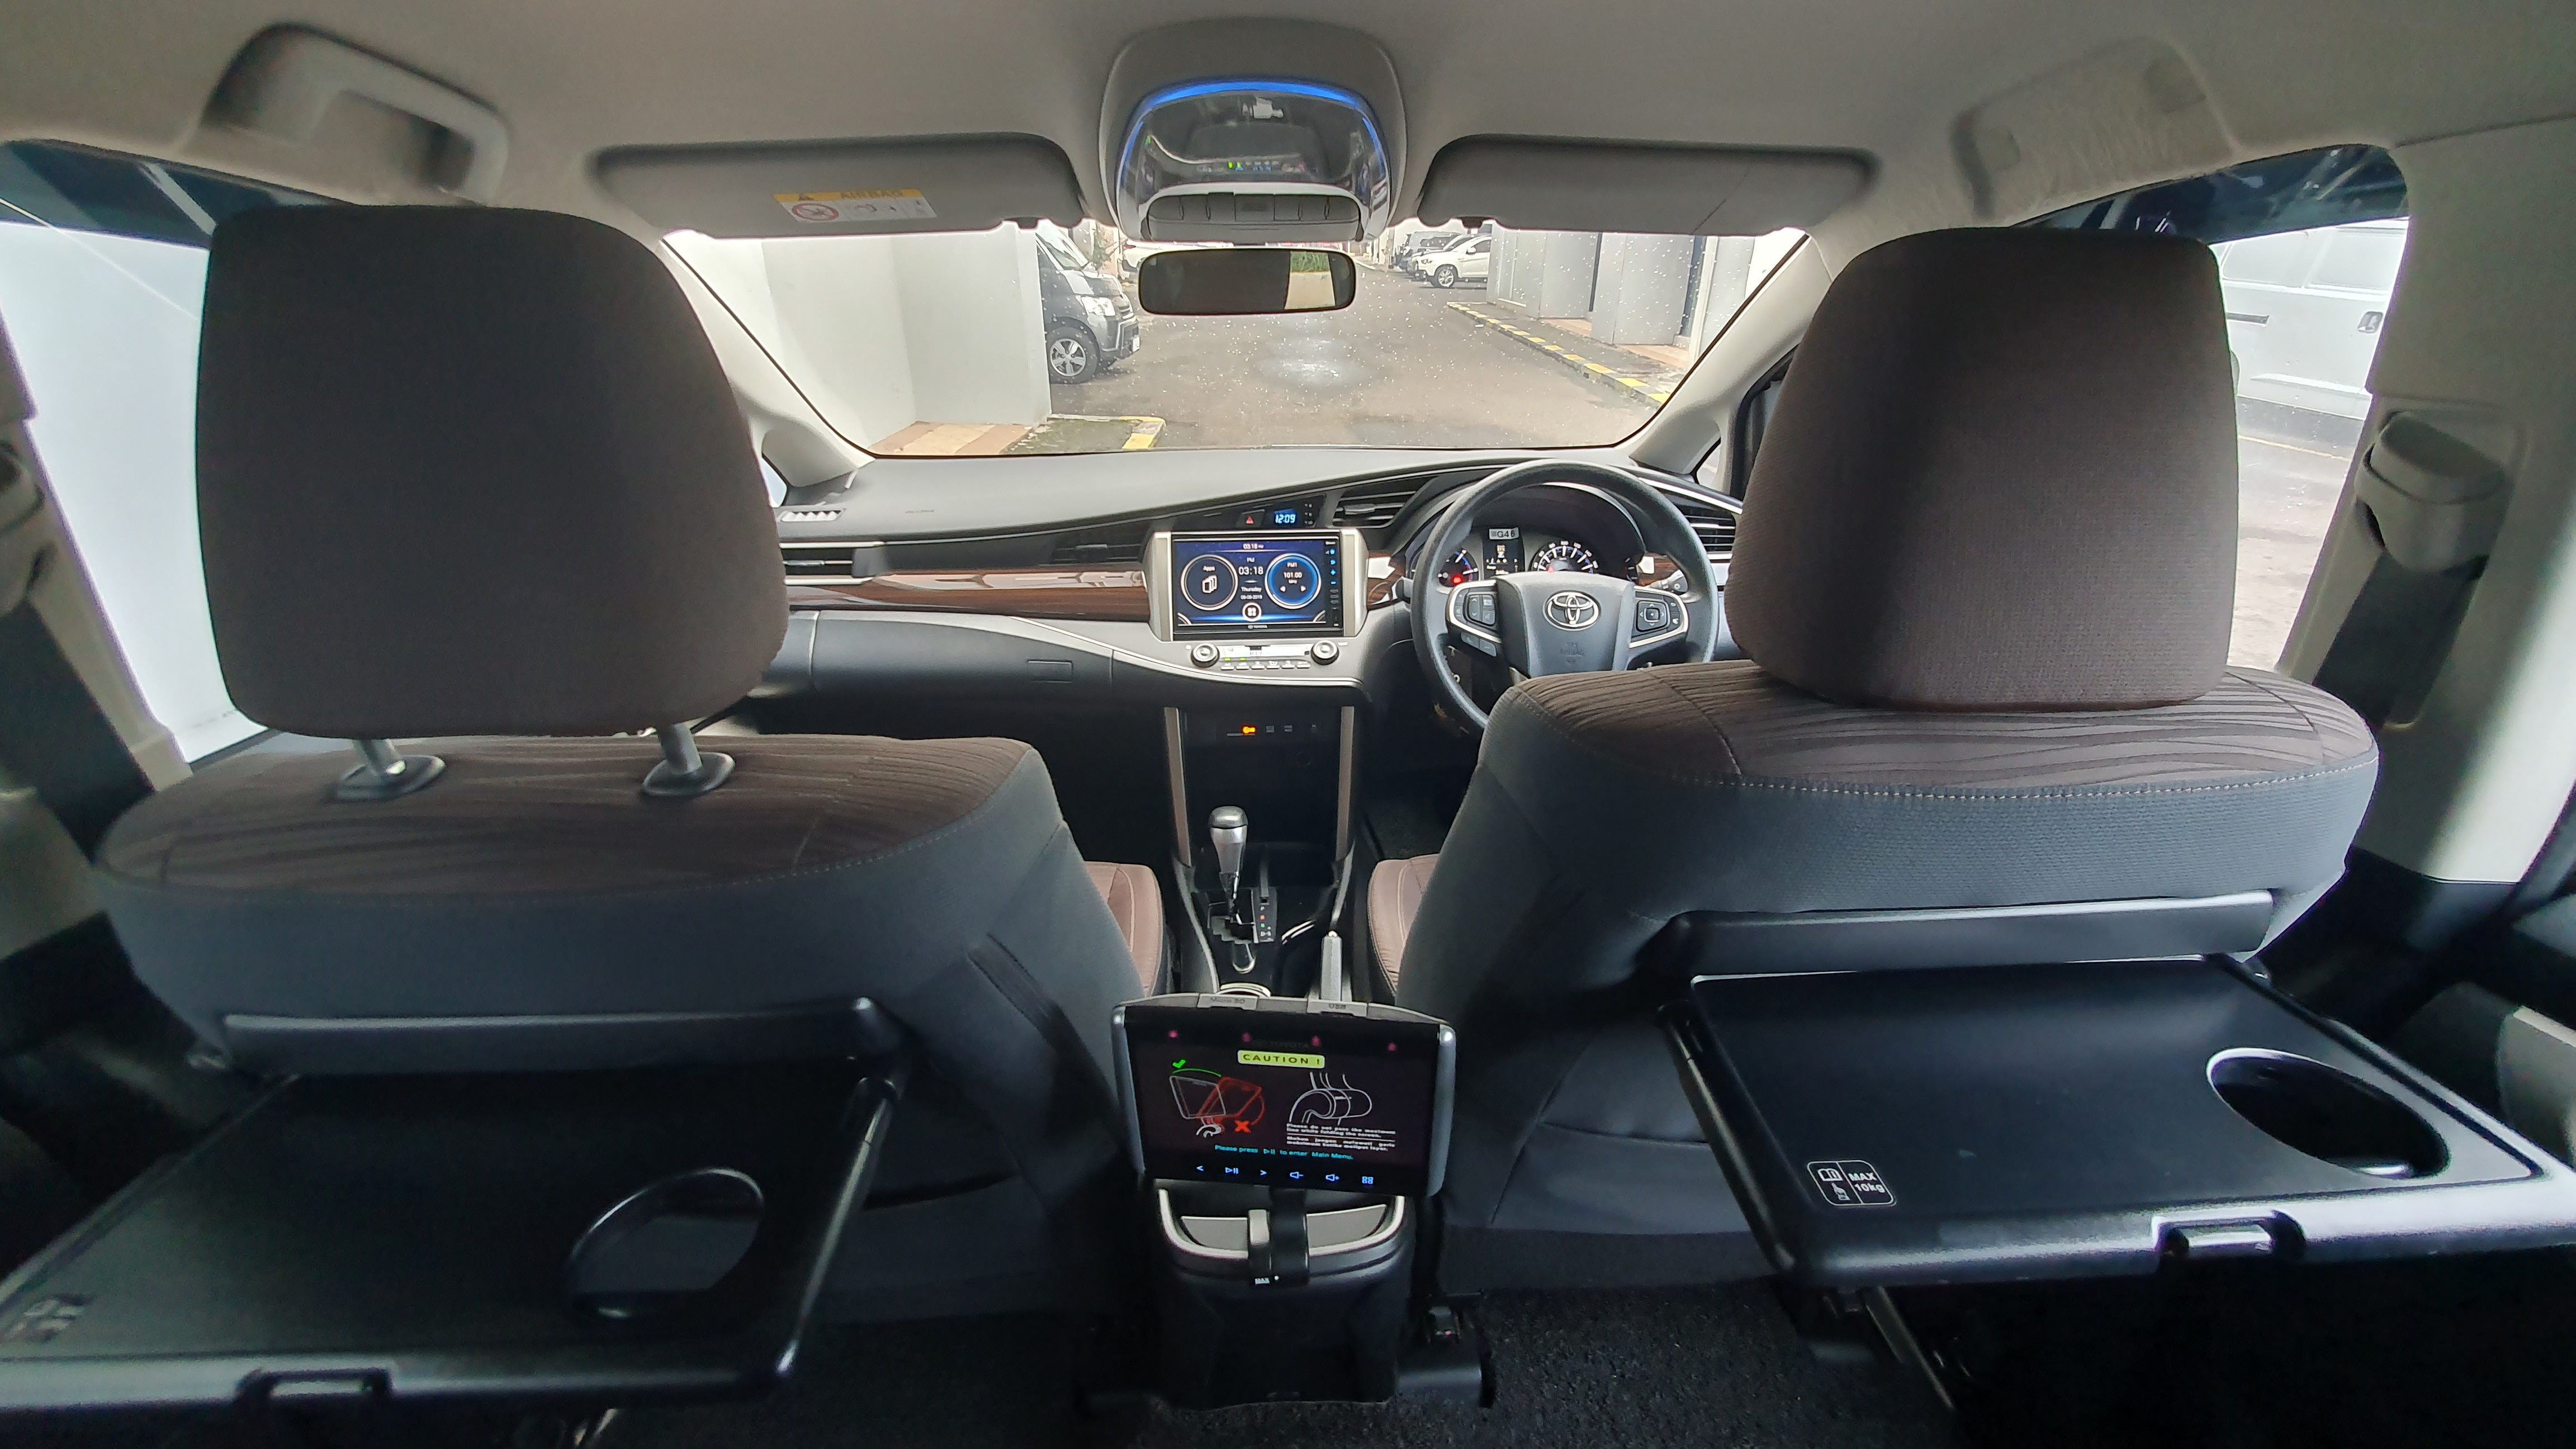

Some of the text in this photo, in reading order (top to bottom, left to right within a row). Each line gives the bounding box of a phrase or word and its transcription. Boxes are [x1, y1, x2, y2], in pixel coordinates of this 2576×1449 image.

[1275, 514, 1296, 524] 12:09
[1238, 566, 1263, 575] 03:18
[1243, 1054, 1309, 1064] CAUTION
[1848, 1172, 1877, 1181] MAX
[1855, 1183, 1886, 1193] 10kg
